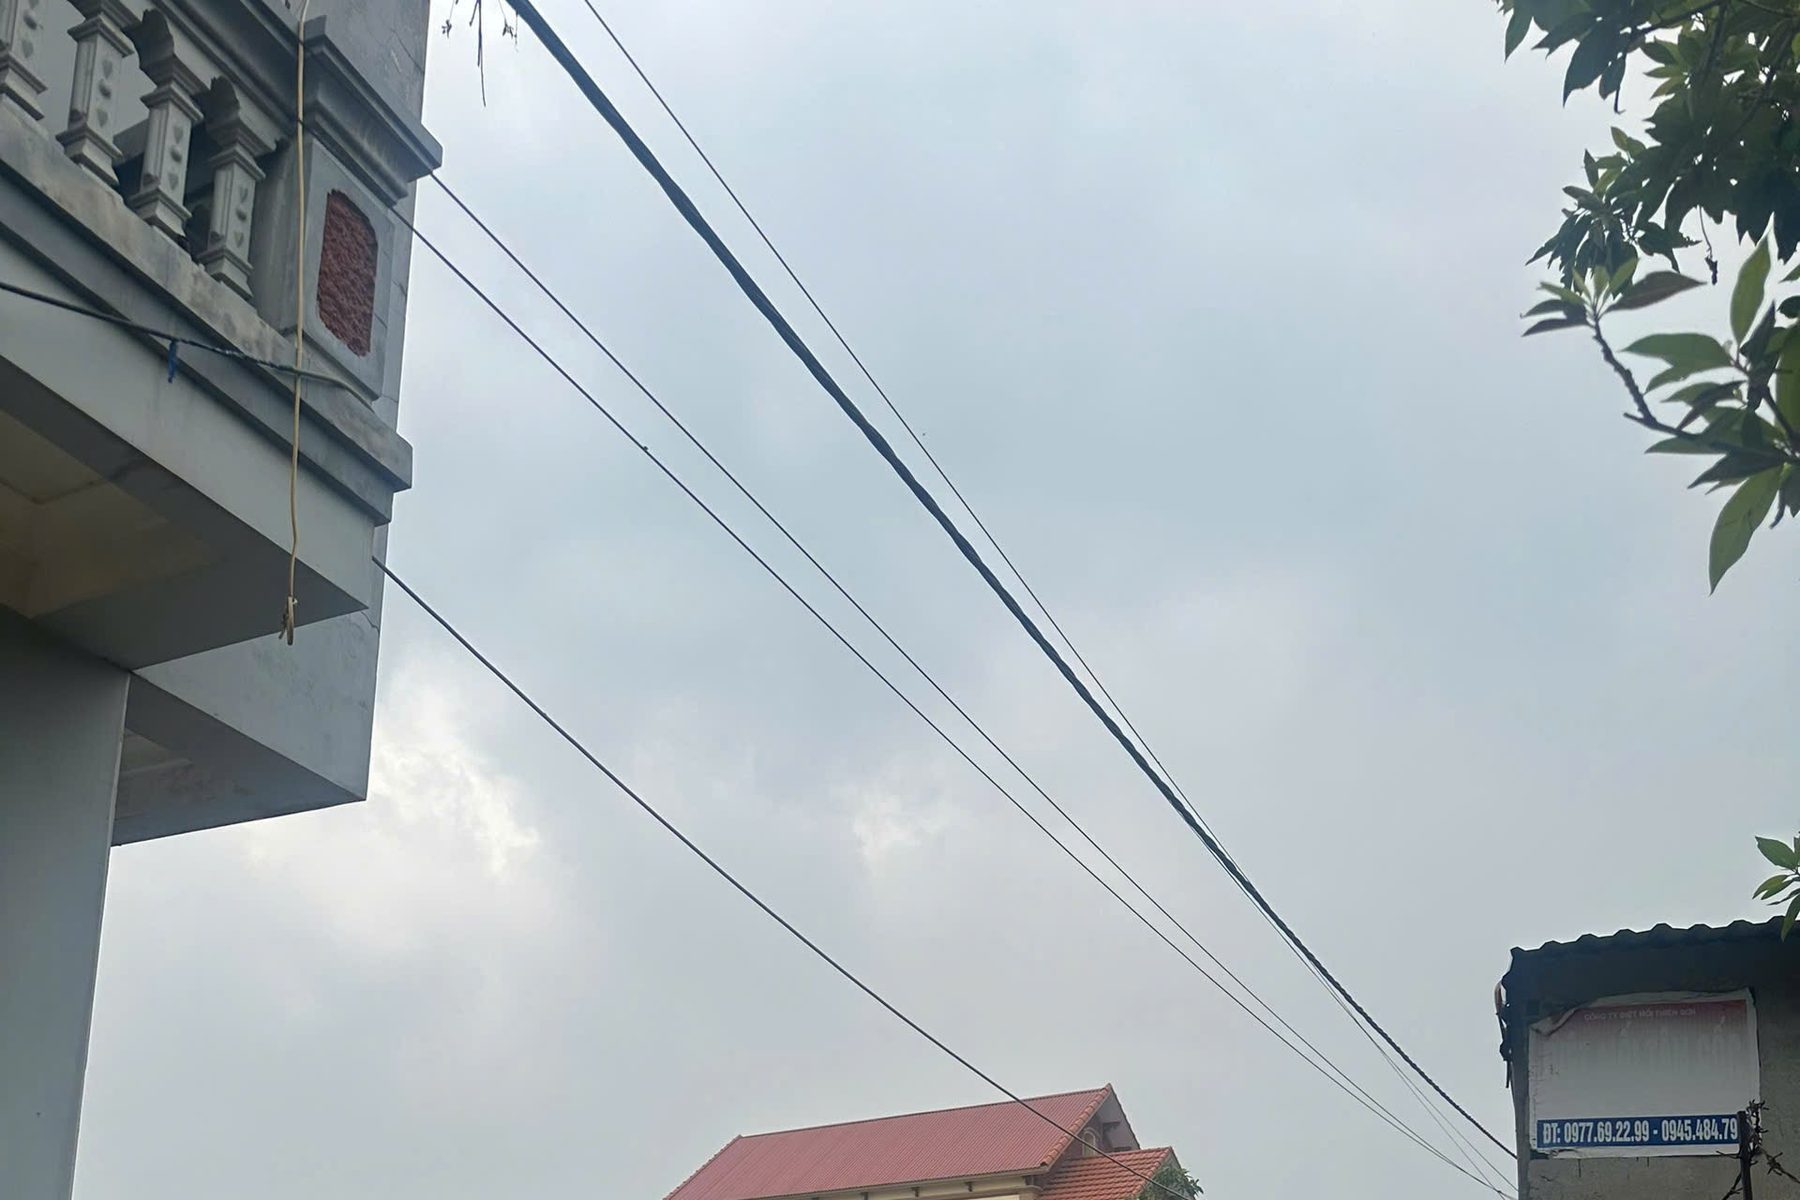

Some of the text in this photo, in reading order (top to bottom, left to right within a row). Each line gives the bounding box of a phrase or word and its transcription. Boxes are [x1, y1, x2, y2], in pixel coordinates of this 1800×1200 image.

[1543, 1123, 1561, 1144] ĐT:
[1564, 1120, 1649, 1143] 0977.69.22.99
[1661, 1118, 1738, 1141] 0945.484.79
